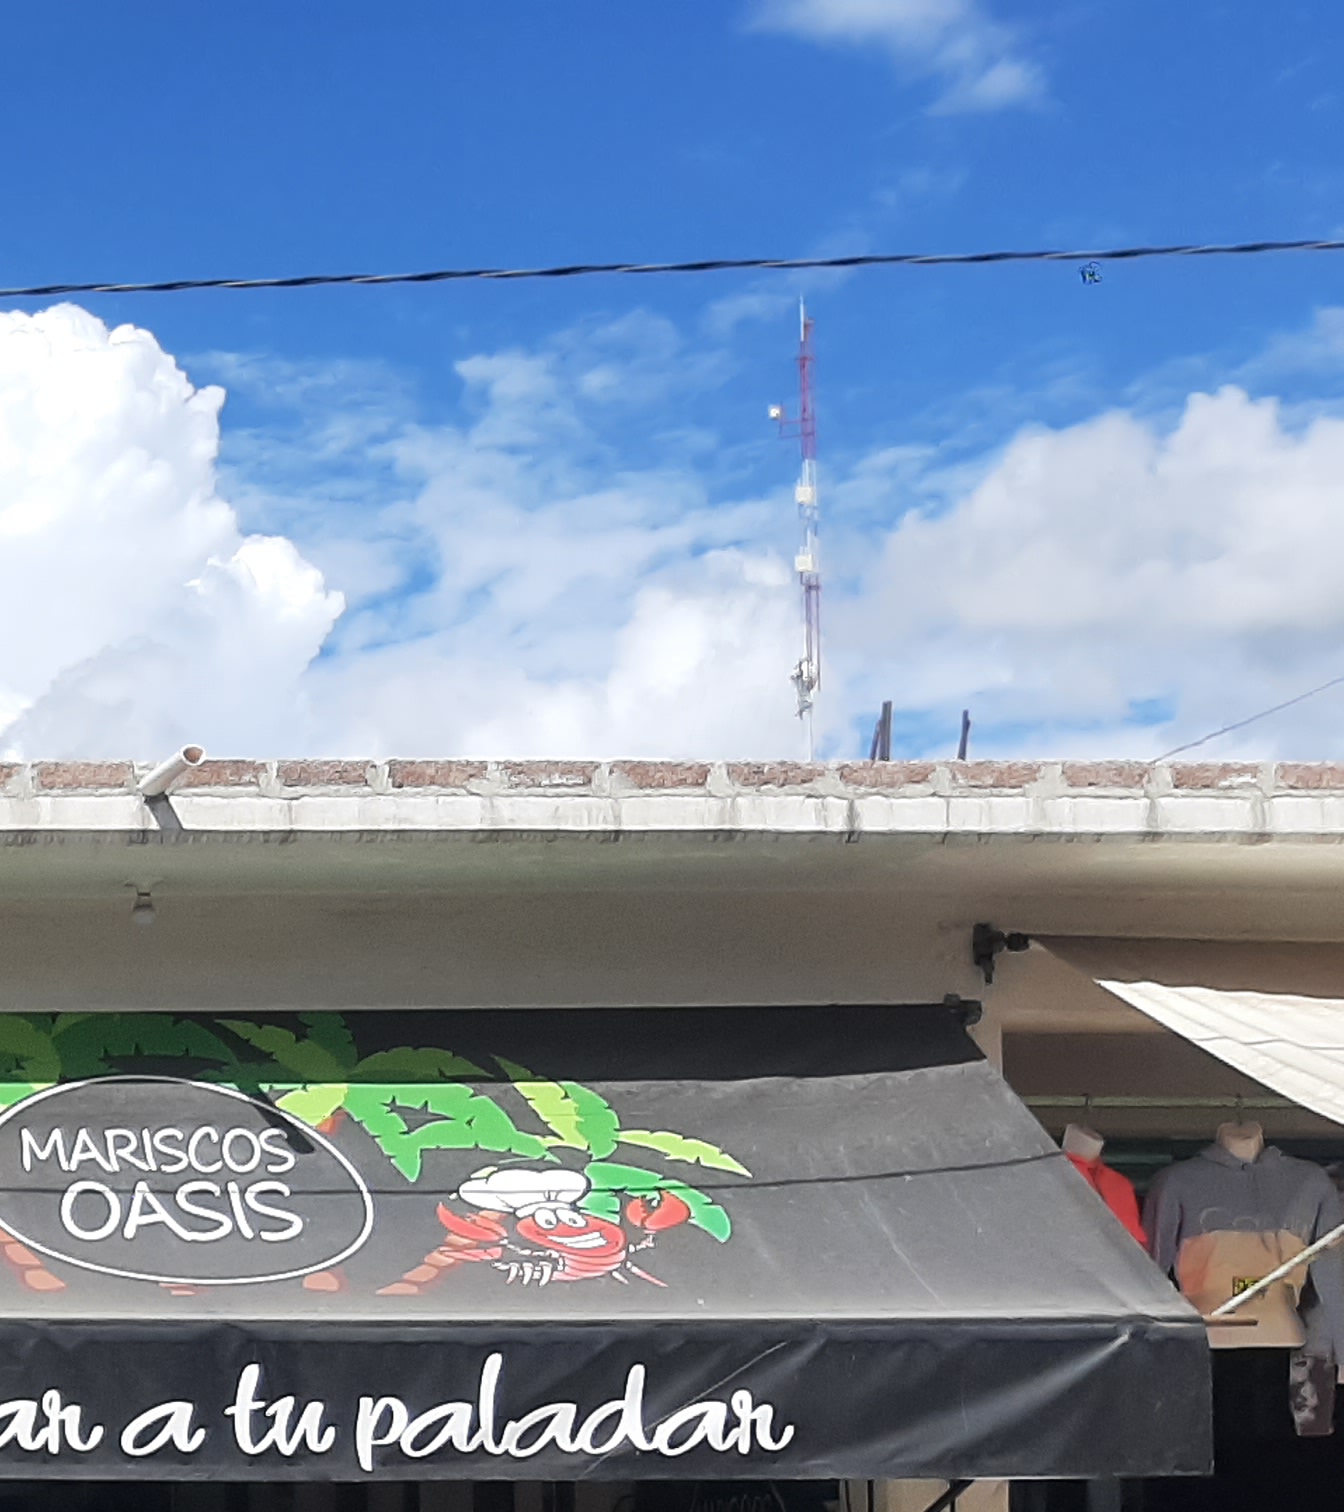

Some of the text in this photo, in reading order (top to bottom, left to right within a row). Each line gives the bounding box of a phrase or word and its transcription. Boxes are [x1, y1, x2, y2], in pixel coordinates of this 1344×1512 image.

[20, 1126, 296, 1173] MARISCOS
[60, 1181, 304, 1241] OASIS
[119, 1400, 206, 1456] a
[224, 1363, 336, 1456] tu
[355, 1353, 795, 1471] paladar
